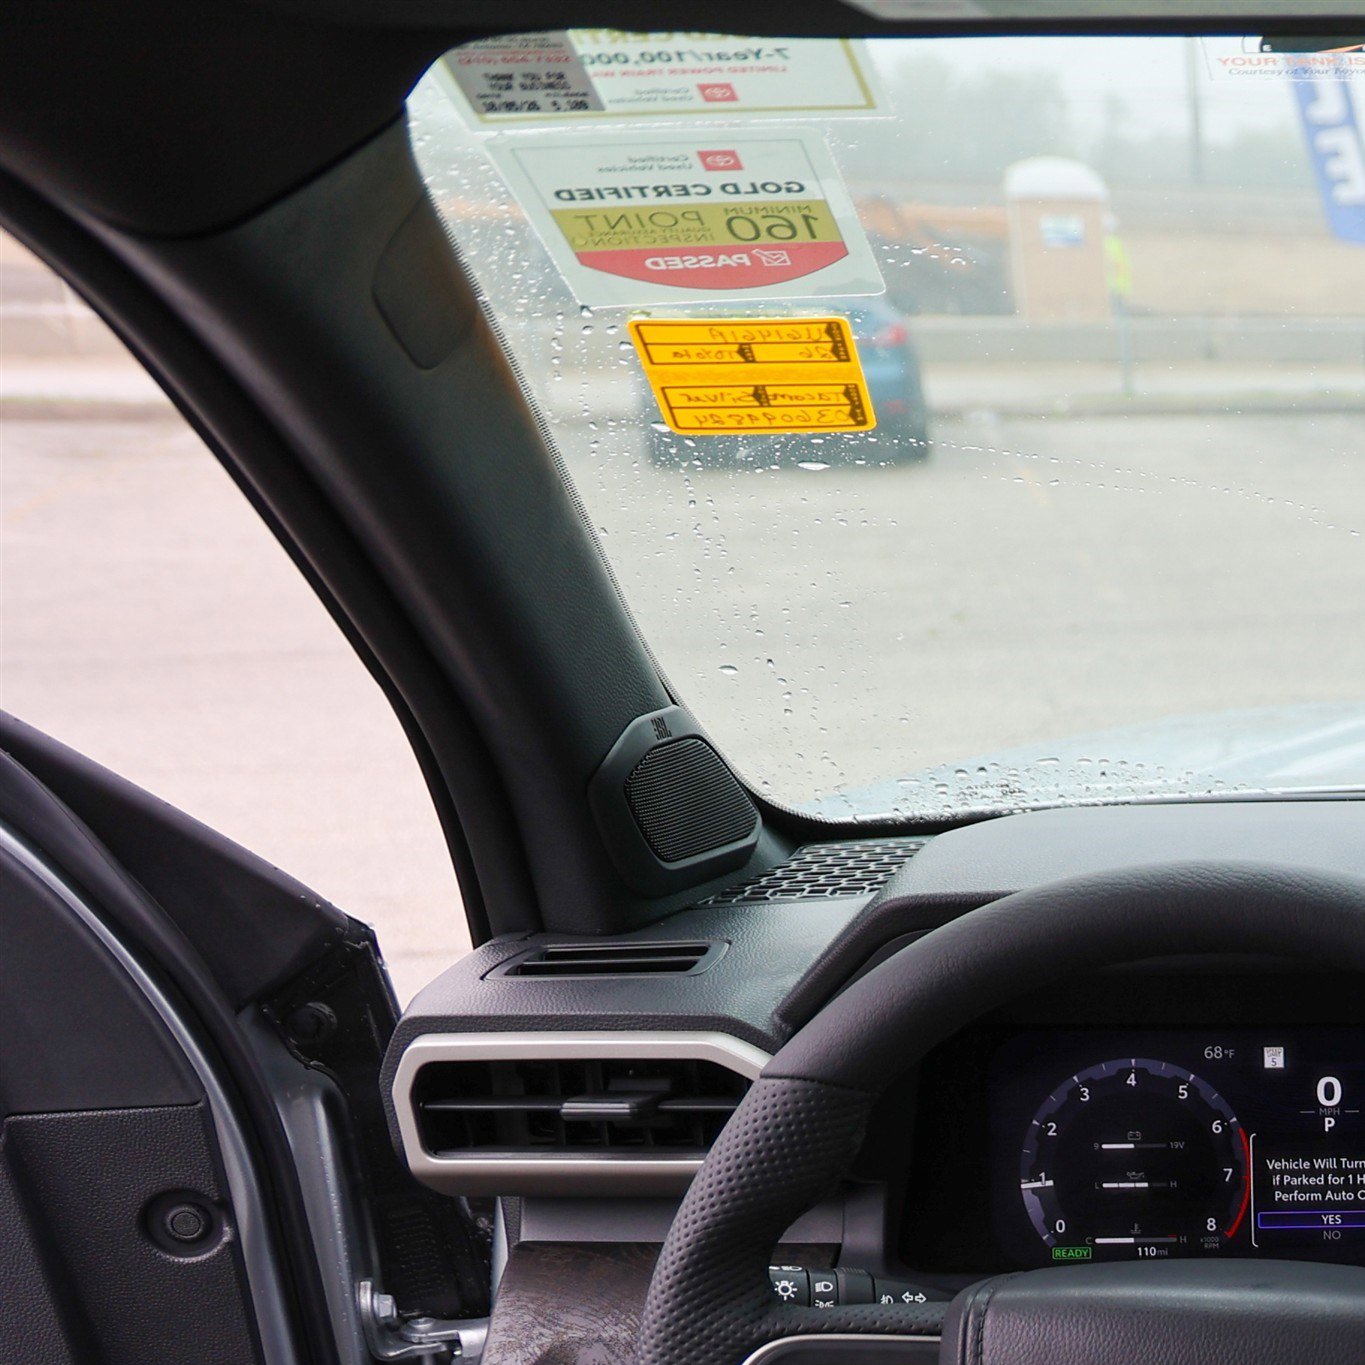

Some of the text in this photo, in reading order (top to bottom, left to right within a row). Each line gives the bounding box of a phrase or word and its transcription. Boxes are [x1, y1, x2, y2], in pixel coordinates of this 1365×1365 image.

[1217, 57, 1277, 67] YOUR
[1287, 56, 1337, 67] TANK
[1228, 67, 1283, 78] Courtesy
[1300, 67, 1333, 77] Your
[1316, 1076, 1343, 1107] 0
[1324, 1117, 1336, 1133] P
[1266, 1159, 1311, 1171] Vehicle
[1312, 1158, 1337, 1170] Will
[1272, 1174, 1282, 1186] if
[1283, 1174, 1325, 1187] Parked
[1327, 1174, 1345, 1185] for
[1347, 1174, 1354, 1185] 1
[1274, 1191, 1323, 1202] Perform
[1324, 1190, 1355, 1202] Auto
[1321, 1214, 1342, 1225] YES
[1323, 1230, 1341, 1241] NO
[1053, 1248, 1089, 1258] READY
